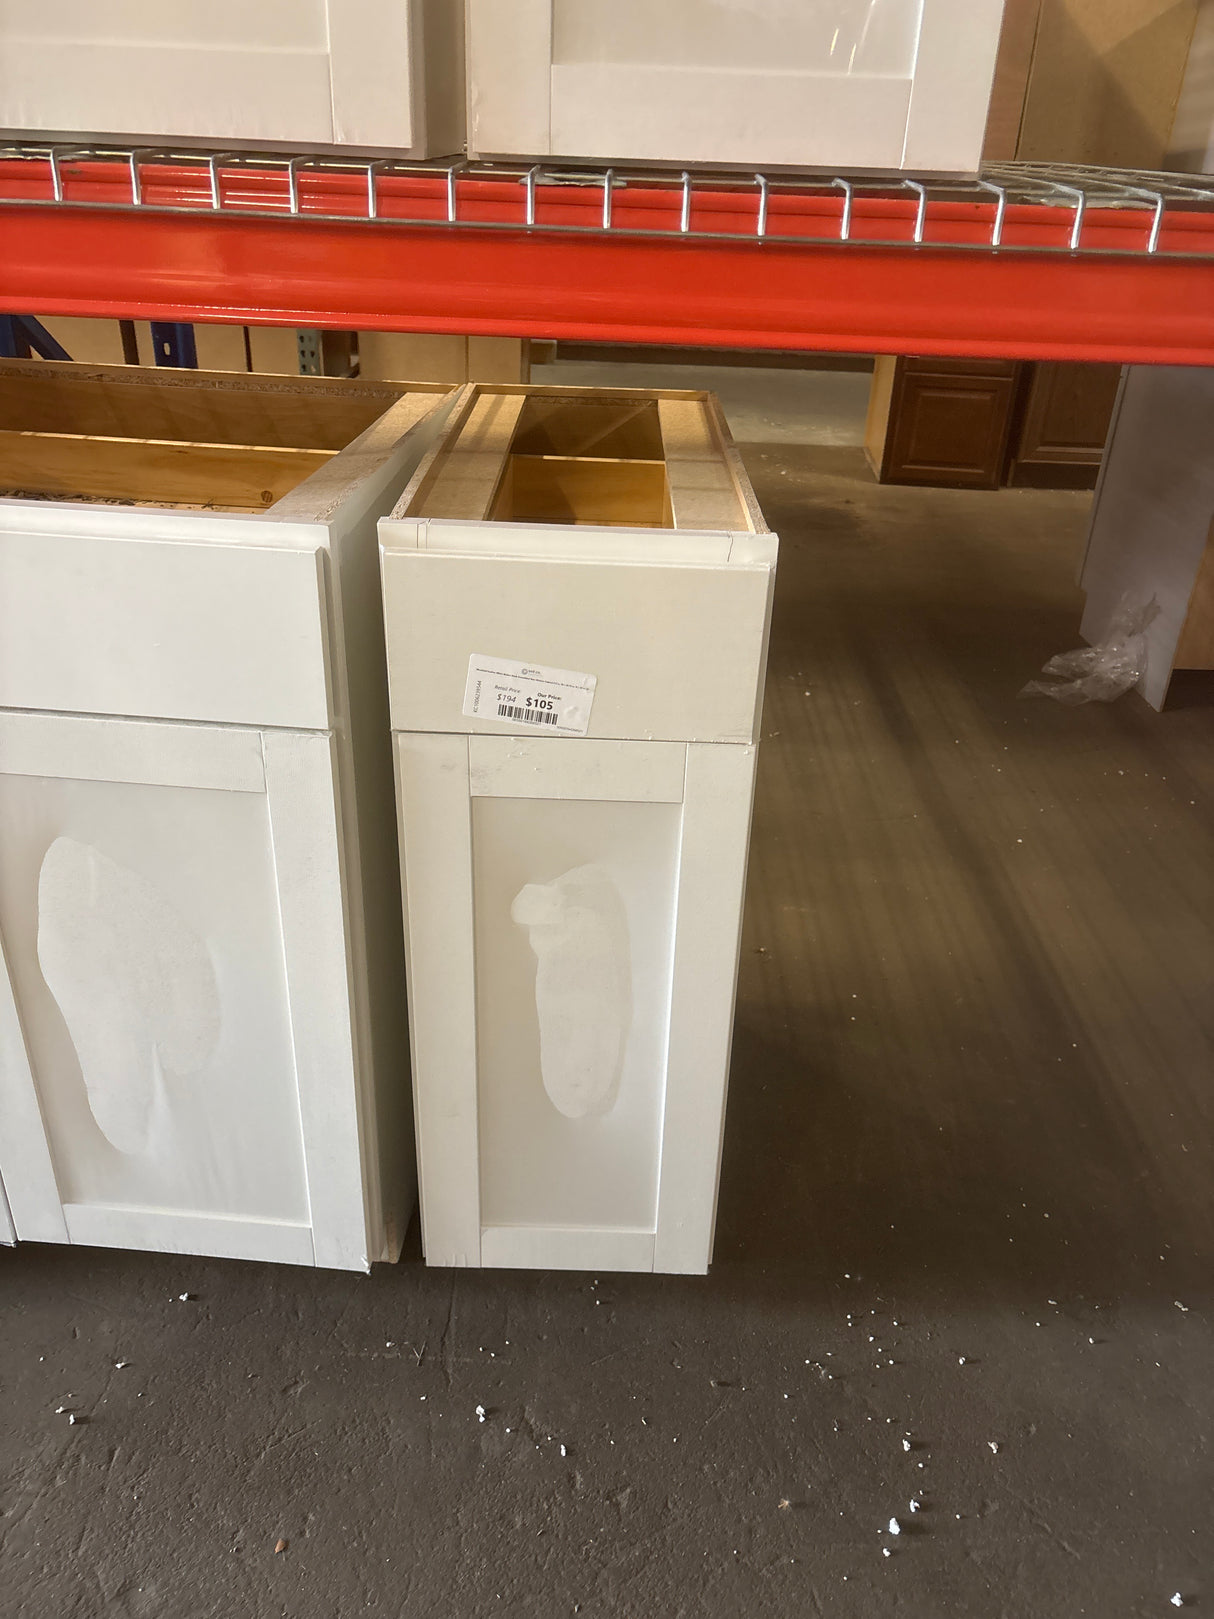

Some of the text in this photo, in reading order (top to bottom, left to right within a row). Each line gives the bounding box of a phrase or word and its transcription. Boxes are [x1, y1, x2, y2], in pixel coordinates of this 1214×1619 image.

[494, 684, 508, 692] Retail
[496, 693, 517, 703] $194
[525, 697, 553, 710] $105
